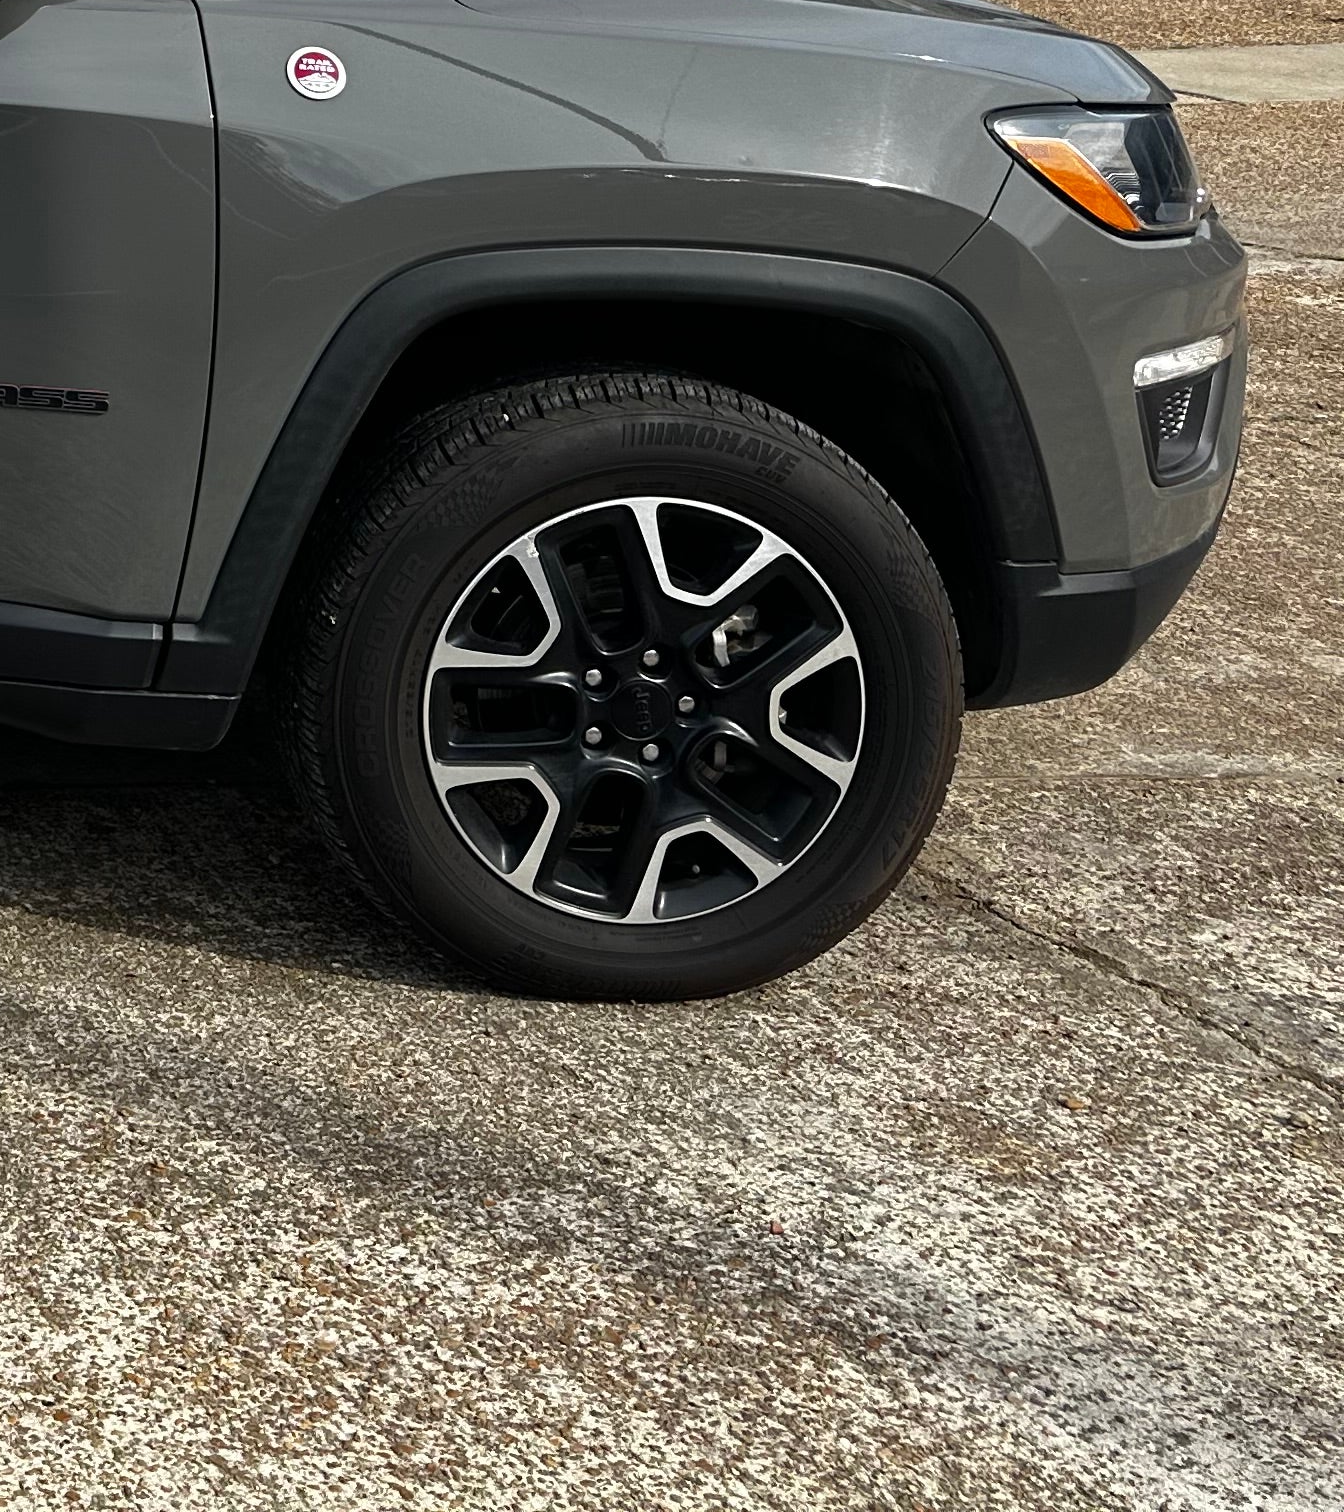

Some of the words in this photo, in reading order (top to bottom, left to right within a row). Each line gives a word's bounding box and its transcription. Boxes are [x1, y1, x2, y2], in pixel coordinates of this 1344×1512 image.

[299, 63, 335, 72] RATED
[663, 422, 802, 476] MOHAVE
[632, 686, 652, 732] Jeep
